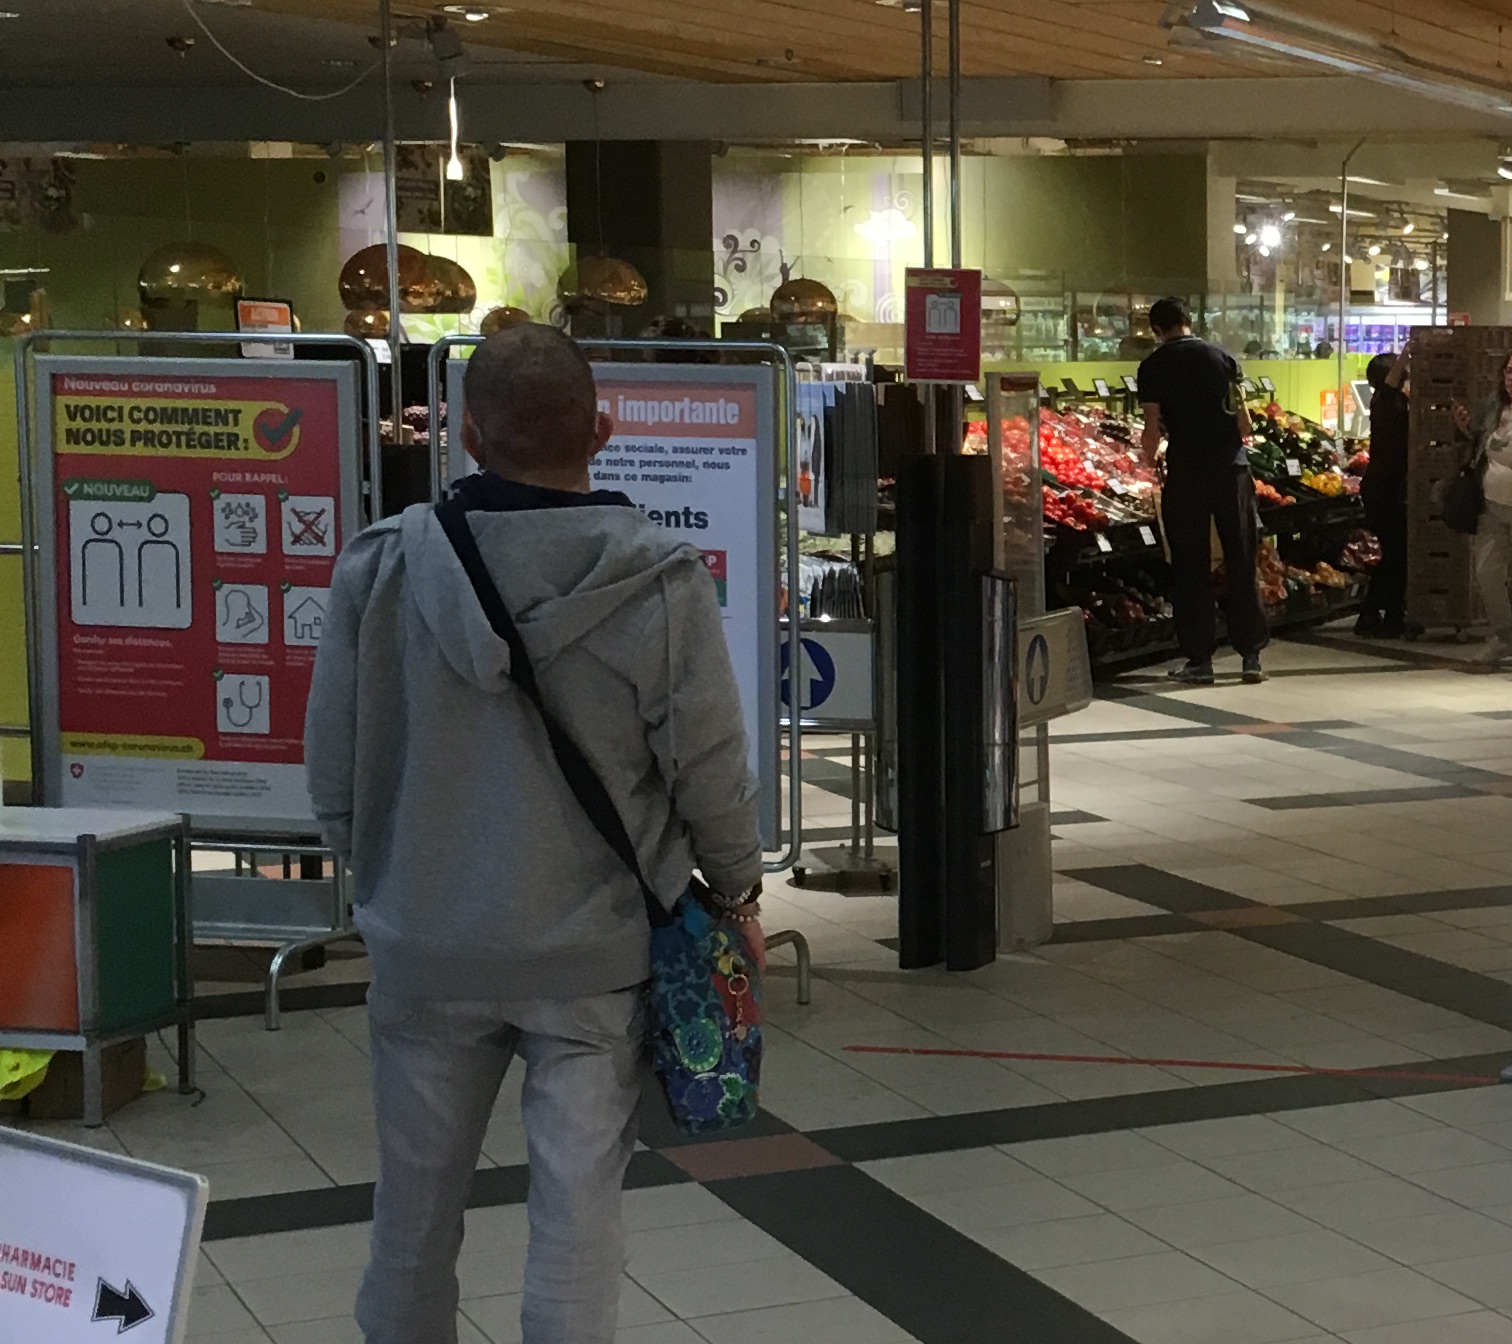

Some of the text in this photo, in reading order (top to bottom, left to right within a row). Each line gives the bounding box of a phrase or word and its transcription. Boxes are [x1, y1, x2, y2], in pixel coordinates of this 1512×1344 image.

[64, 377, 217, 394] Nouveau coronavirus
[65, 404, 242, 427] VOICI COMMENT
[618, 395, 739, 426] importante
[65, 427, 126, 447] NOUS
[624, 443, 668, 456] sociale,
[672, 445, 715, 455] assurer
[718, 446, 748, 456] votre
[606, 457, 636, 467] notre
[639, 459, 699, 470] personnel,
[703, 461, 731, 470] nous
[213, 472, 242, 482] POUR
[594, 470, 621, 481] dans
[624, 473, 638, 481] ce
[83, 484, 150, 497] NOUVEAU
[0, 1242, 76, 1282] HARMACIE
[0, 1270, 73, 1308] SUN STORE
